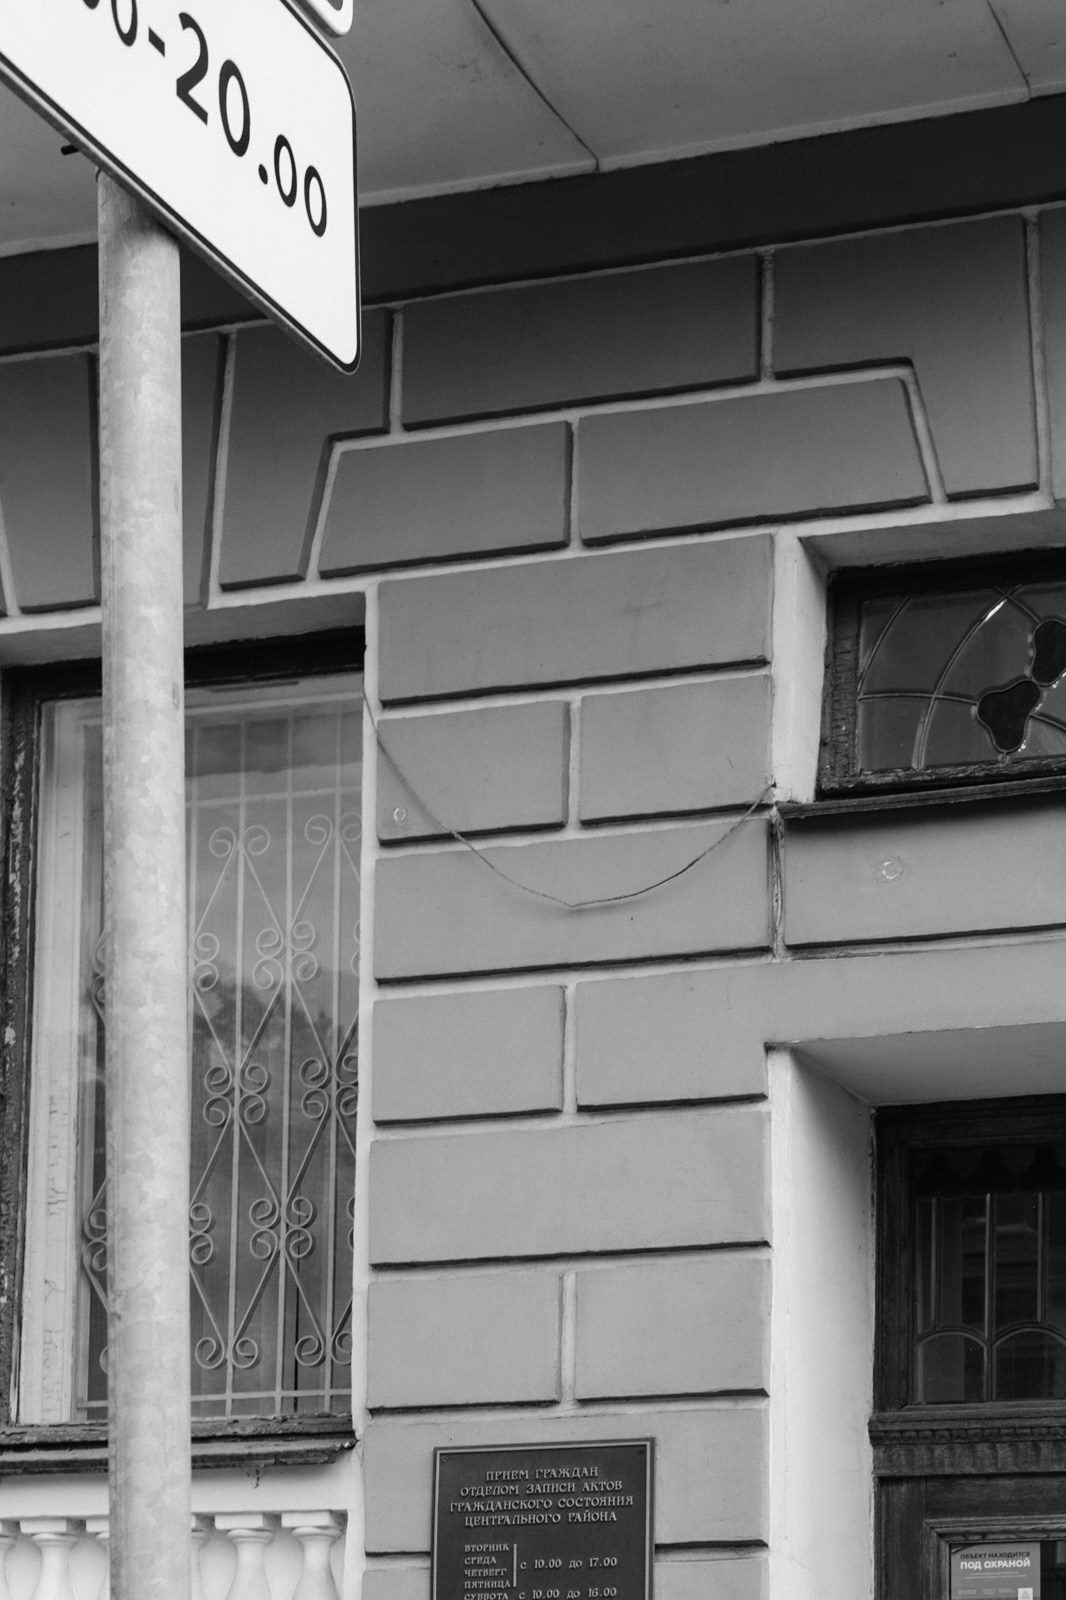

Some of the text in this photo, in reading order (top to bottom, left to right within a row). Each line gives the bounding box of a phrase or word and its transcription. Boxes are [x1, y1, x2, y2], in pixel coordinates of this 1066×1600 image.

[486, 1467, 598, 1481] ПРИЕМ ГРАЖДАН
[461, 1481, 622, 1497] ОТДЕЛОМ ЗАПИСИ АКТОВ
[450, 1496, 633, 1512] ГРАЖДАНСКОГО СОСТОЯНИЯ
[465, 1510, 617, 1527] ЦЕНТРАЛЬНОГО РАЙОНА
[465, 1544, 509, 1552] ВТОРНИК
[465, 1556, 496, 1565] СРЕДА
[534, 1559, 562, 1569] 10.00
[589, 1557, 617, 1567] 17.00
[961, 1558, 1030, 1570] ПОД ОХРАНОЙ
[465, 1568, 507, 1577] ЧЕТВЕРГ
[464, 1580, 510, 1589] ПЯТНИЦА
[464, 1593, 508, 1600] СУББОТА
[532, 1589, 560, 1599] 10.00
[588, 1587, 617, 1597] 16.00
